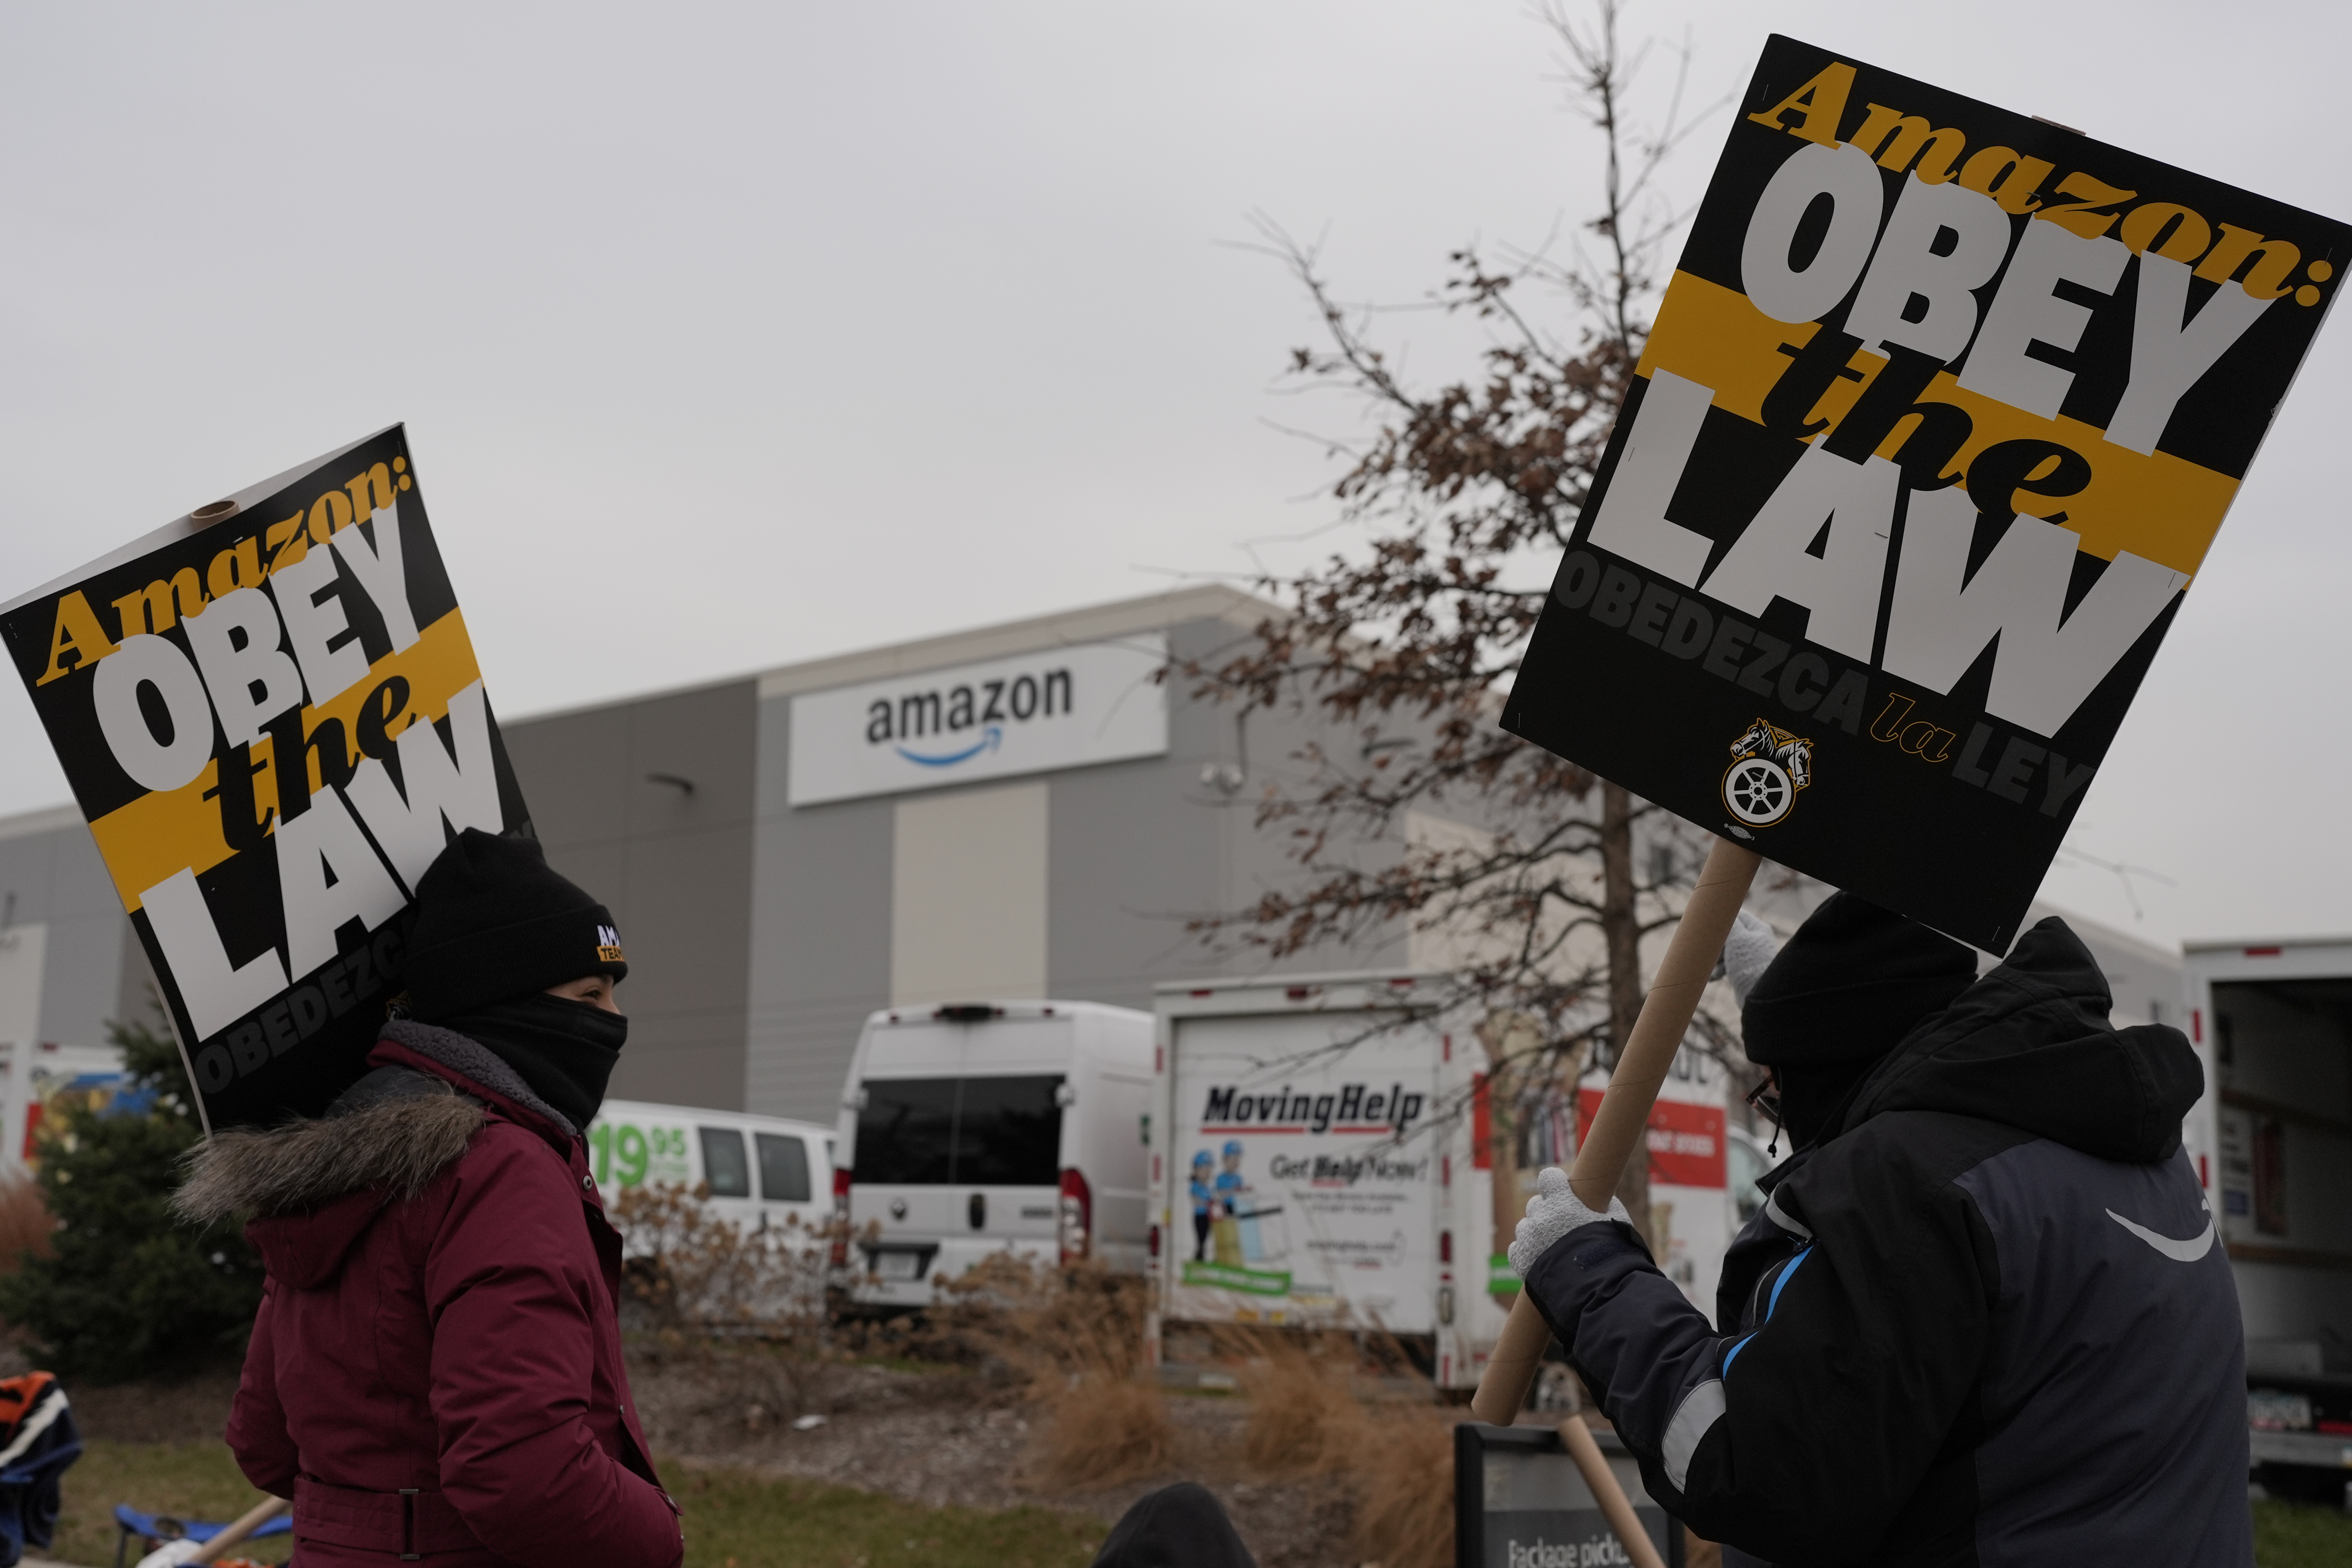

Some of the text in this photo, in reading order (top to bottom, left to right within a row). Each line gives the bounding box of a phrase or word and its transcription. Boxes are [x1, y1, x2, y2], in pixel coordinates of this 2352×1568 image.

[1740, 139, 2278, 457] OBEY
[1747, 61, 2332, 307] Amazon:
[1761, 321, 2093, 526] the
[36, 456, 411, 687] Amazon:
[93, 497, 420, 791] OBEY
[1586, 366, 2192, 739] LAW
[202, 675, 416, 851] the
[865, 666, 1072, 745] amazon
[1553, 550, 2096, 818] OBEDEZCA la LEY
[138, 677, 504, 1042] LAW
[194, 912, 416, 1094] OBEDEZC
[1203, 1084, 1423, 1133] MovingHelp
